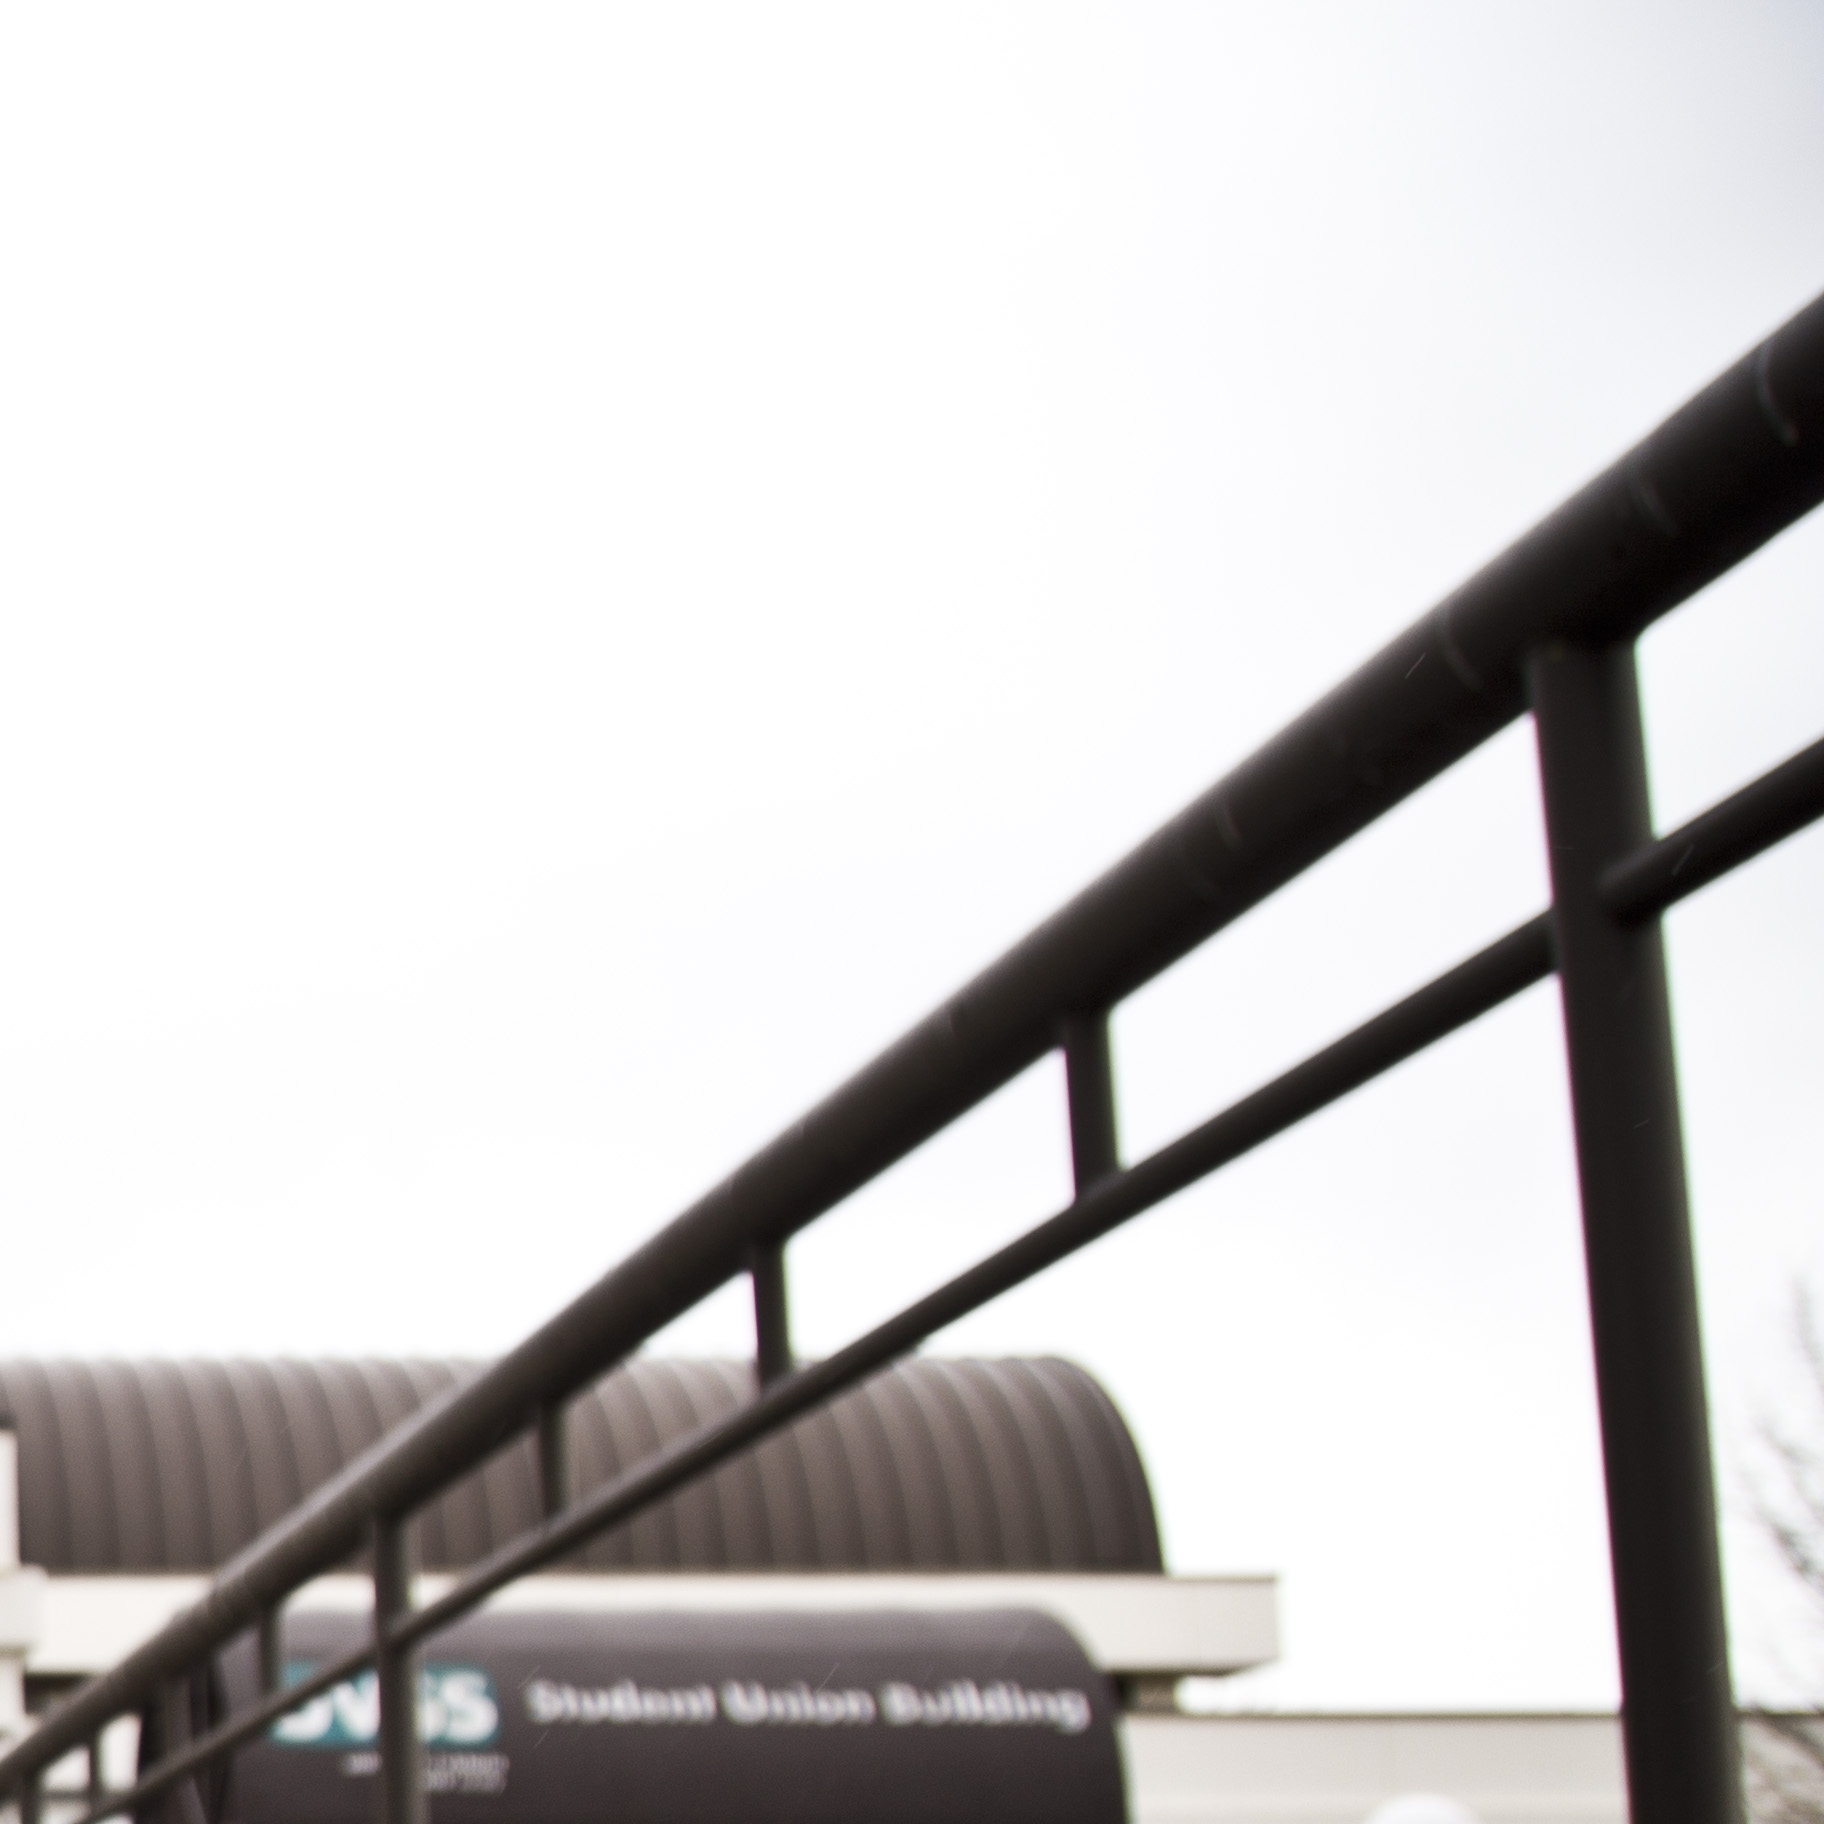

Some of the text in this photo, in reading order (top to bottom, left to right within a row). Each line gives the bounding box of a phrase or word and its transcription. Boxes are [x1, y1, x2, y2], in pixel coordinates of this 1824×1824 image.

[526, 1678, 1092, 1734] Student Union Building
